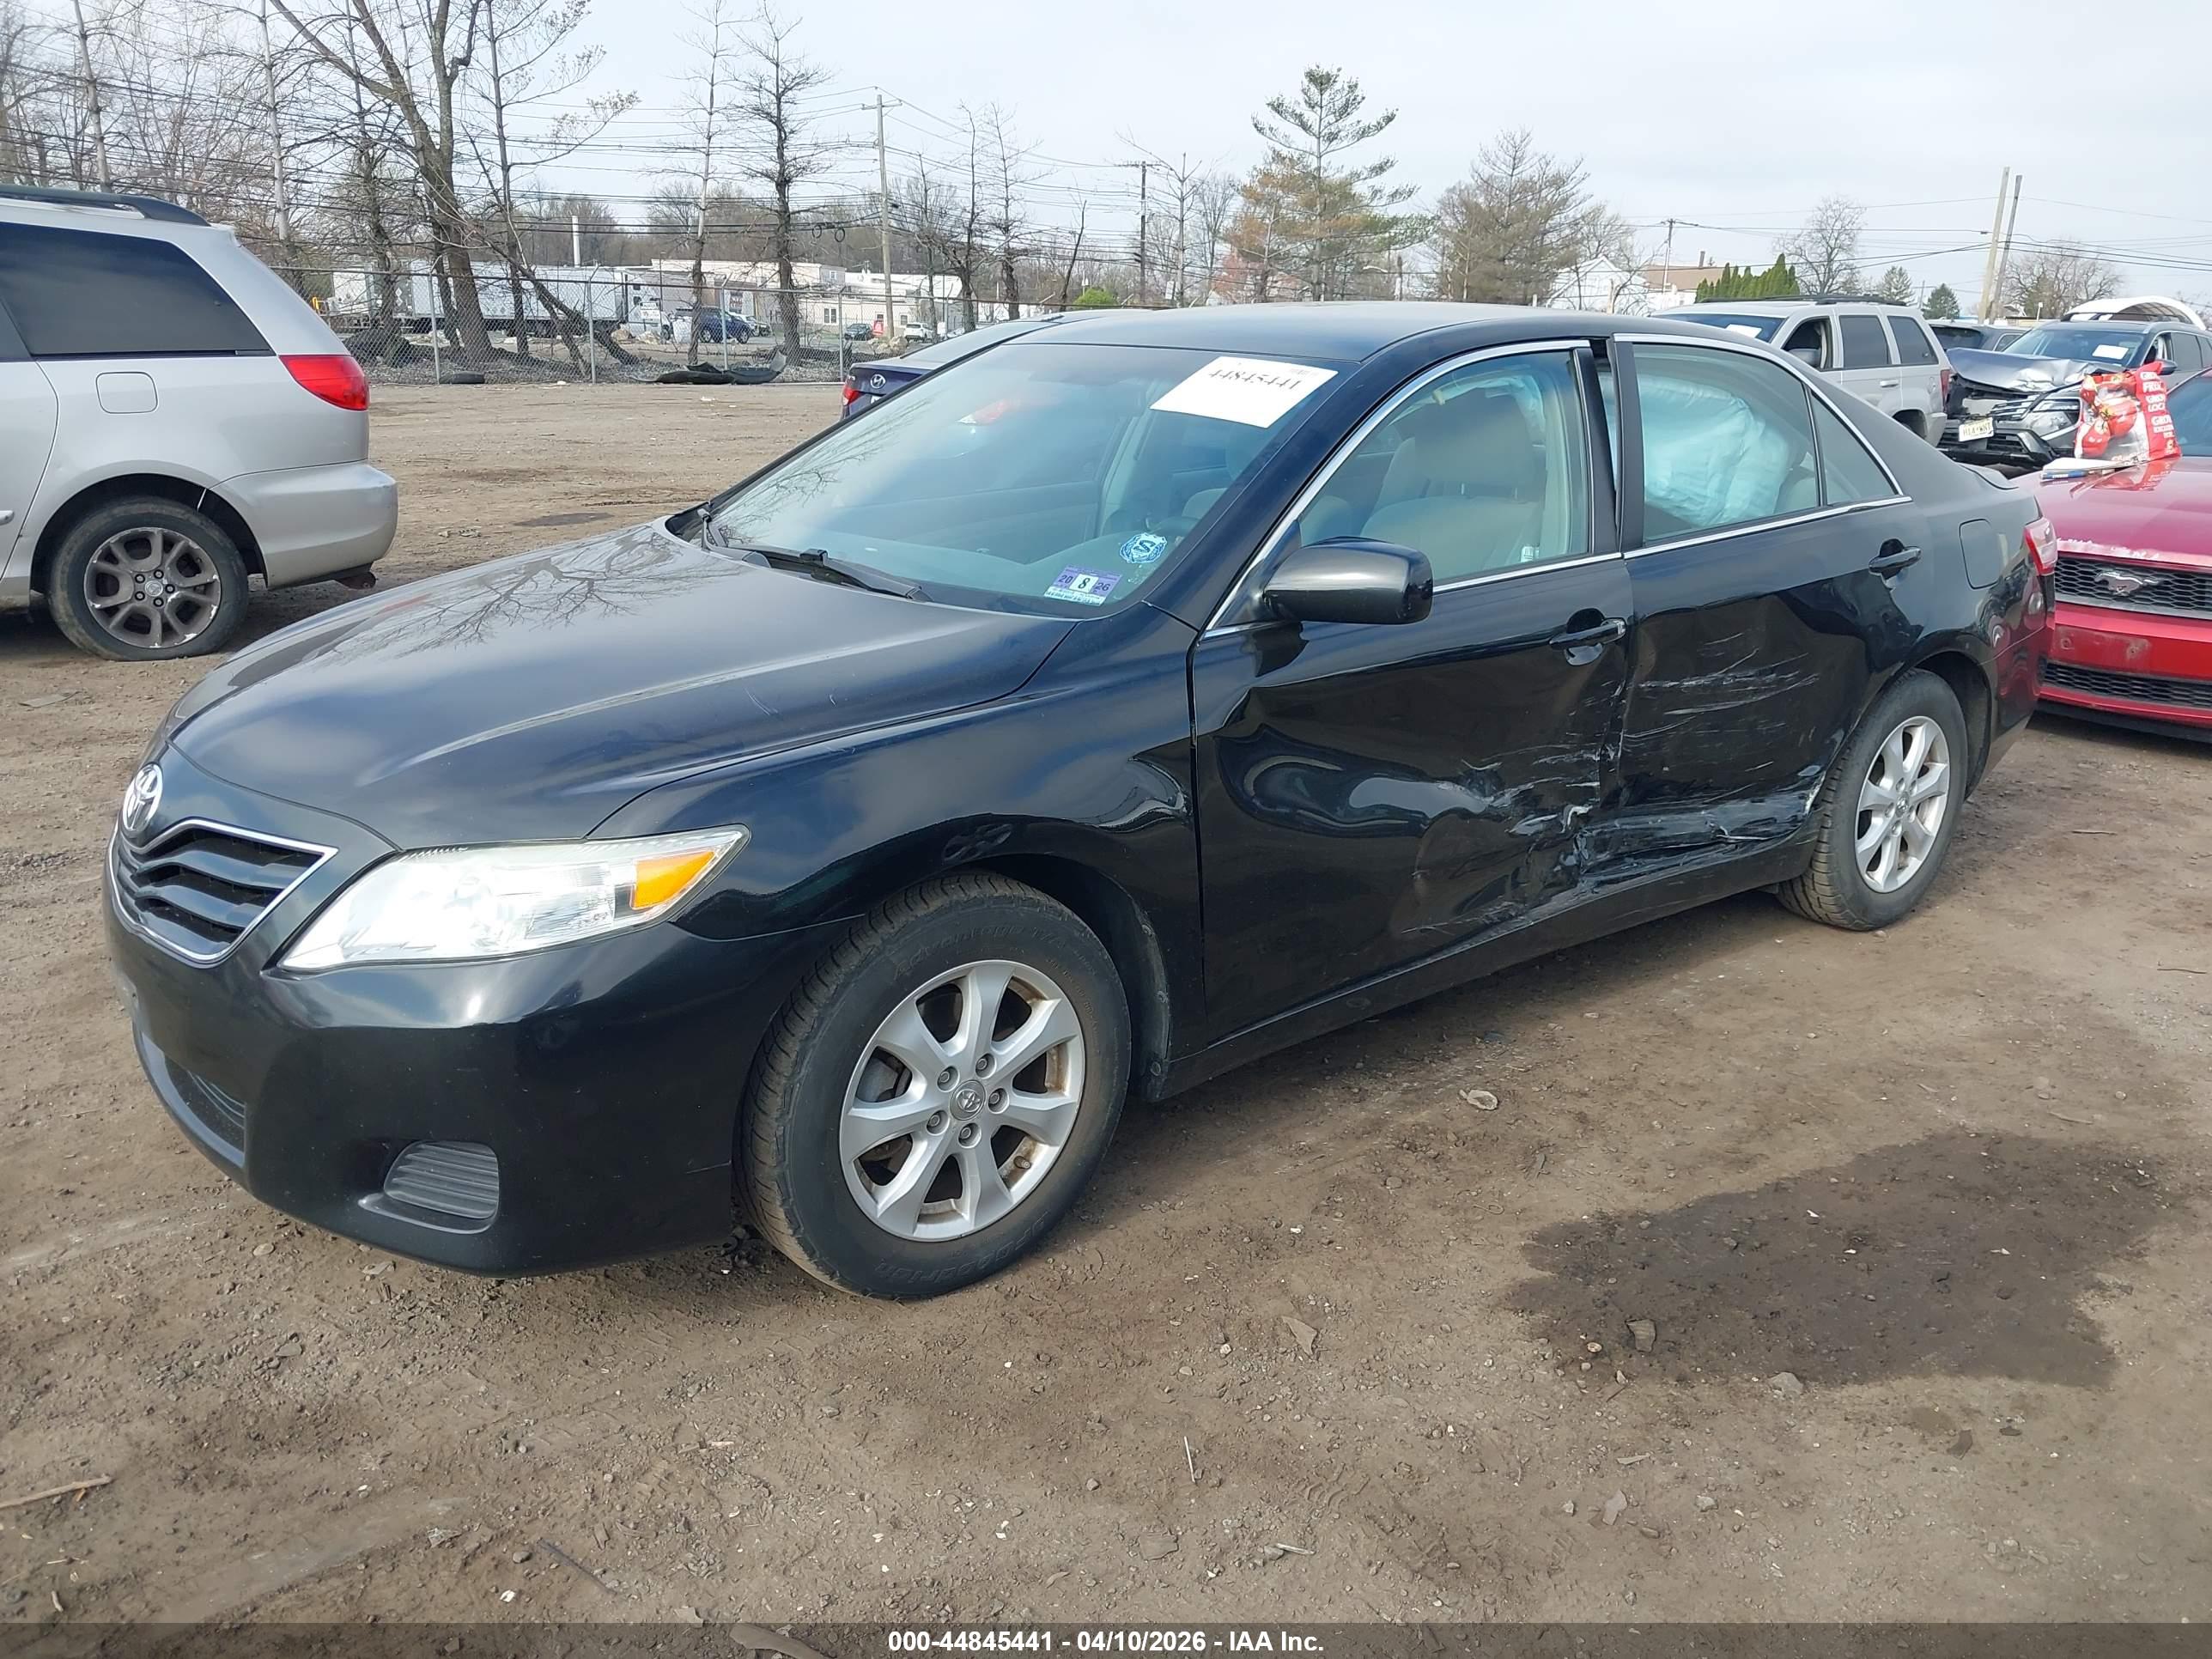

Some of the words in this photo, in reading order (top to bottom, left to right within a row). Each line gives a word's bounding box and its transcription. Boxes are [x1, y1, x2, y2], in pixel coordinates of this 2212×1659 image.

[1058, 574, 1073, 584] 20
[1078, 577, 1091, 589] 8
[1095, 582, 1110, 592] 26
